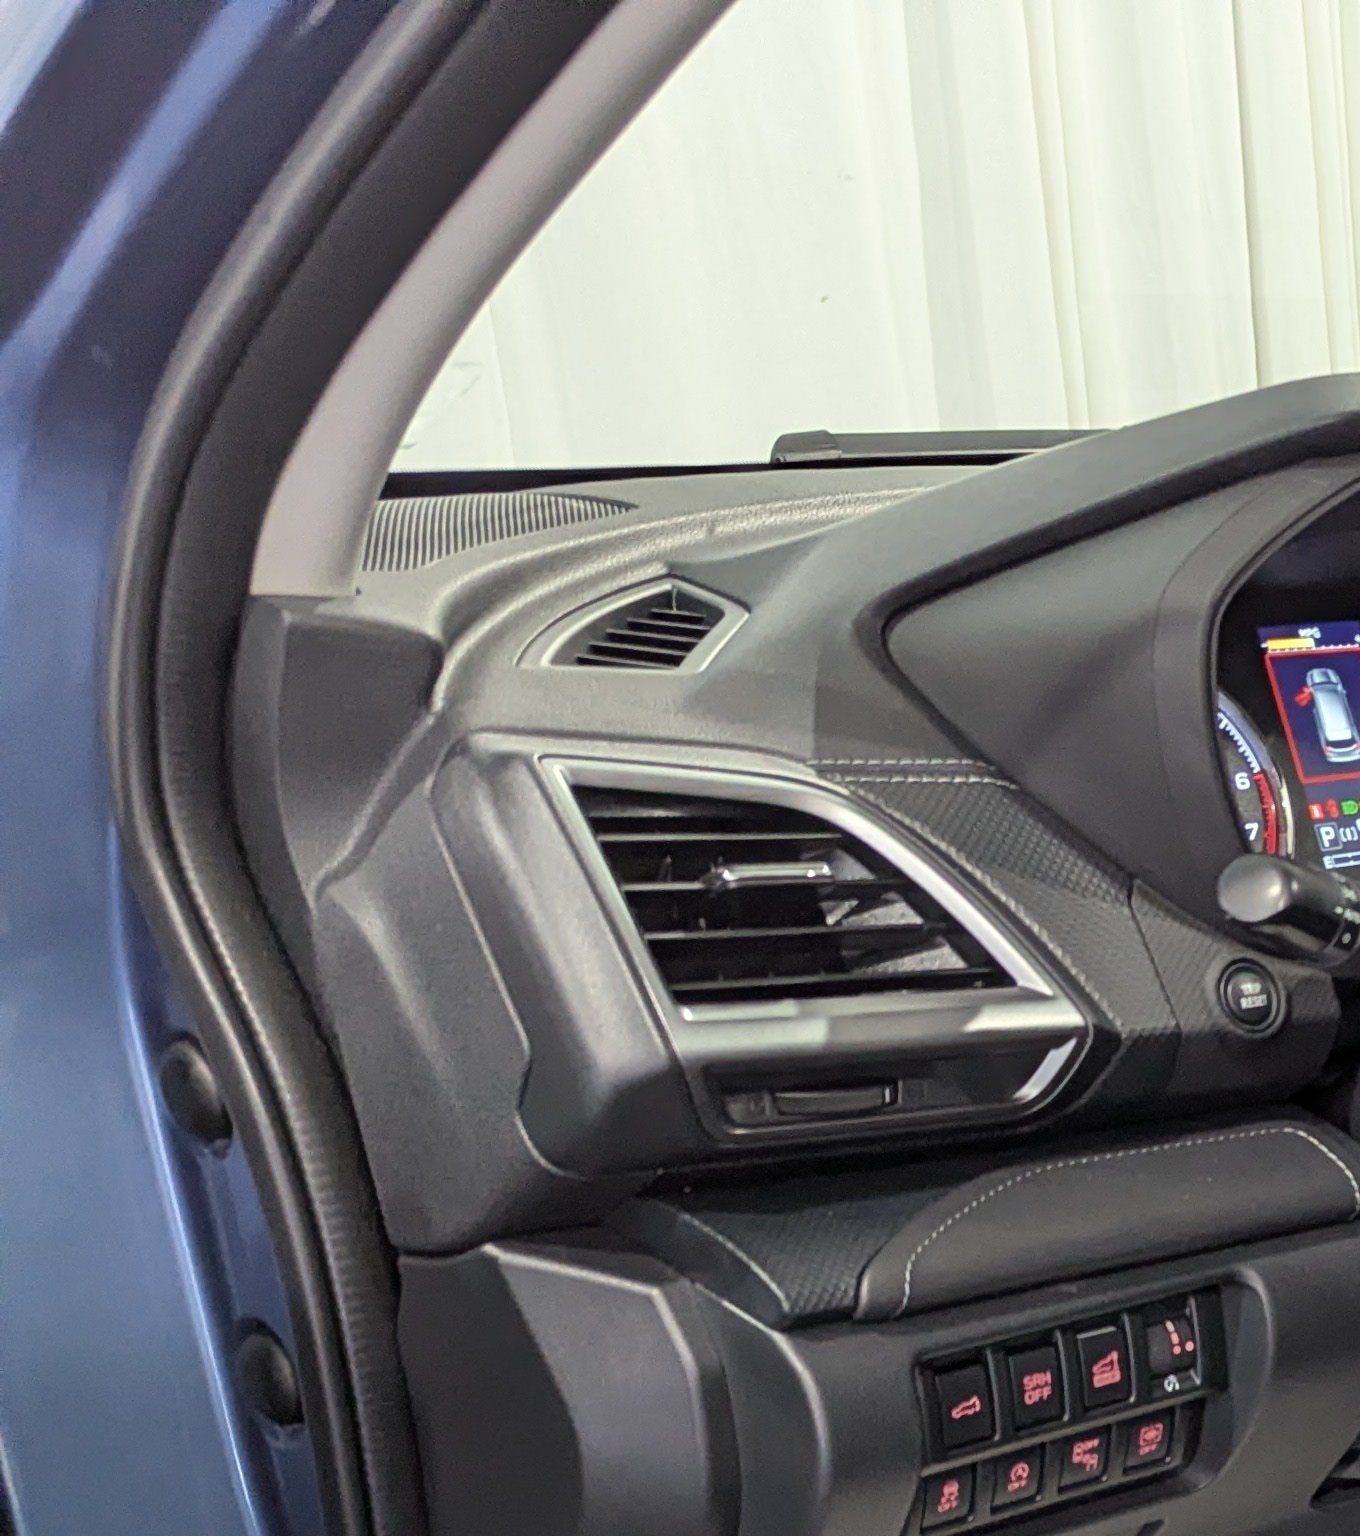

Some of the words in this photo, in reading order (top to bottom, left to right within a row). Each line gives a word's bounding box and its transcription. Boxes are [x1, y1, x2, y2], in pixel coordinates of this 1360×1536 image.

[1234, 772, 1250, 790] 6
[1245, 822, 1259, 841] 7
[1320, 826, 1335, 848] P
[1024, 1386, 1051, 1405] OFF
